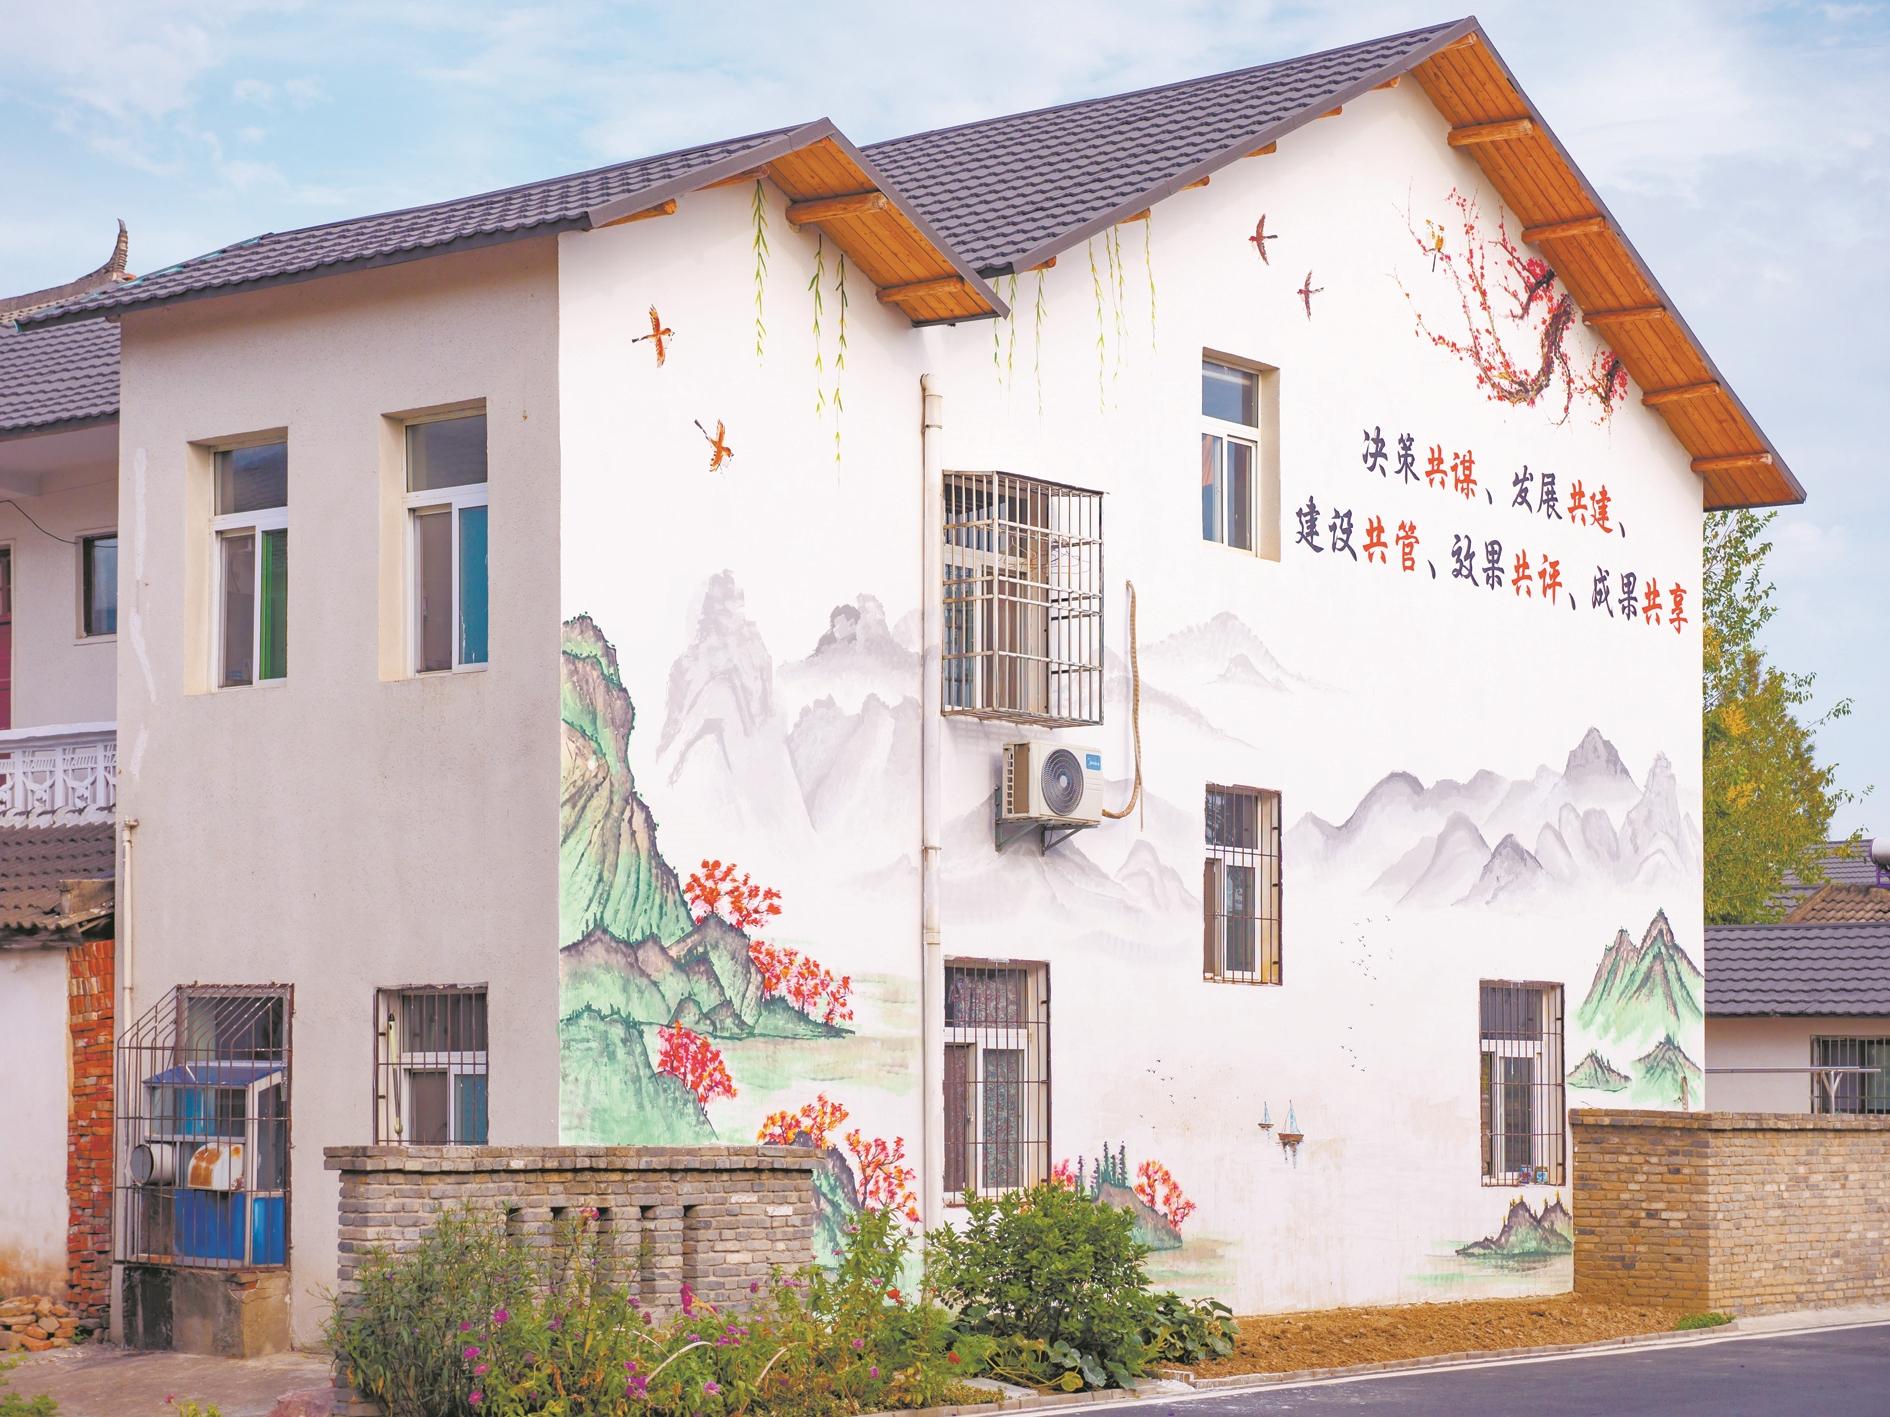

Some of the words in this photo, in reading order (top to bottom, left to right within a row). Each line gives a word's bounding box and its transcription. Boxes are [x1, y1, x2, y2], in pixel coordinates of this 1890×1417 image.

[1362, 425, 1627, 539] 决策共谋、发展共建、
[1295, 495, 1689, 635] 建设共管、效果共评、成果共享
